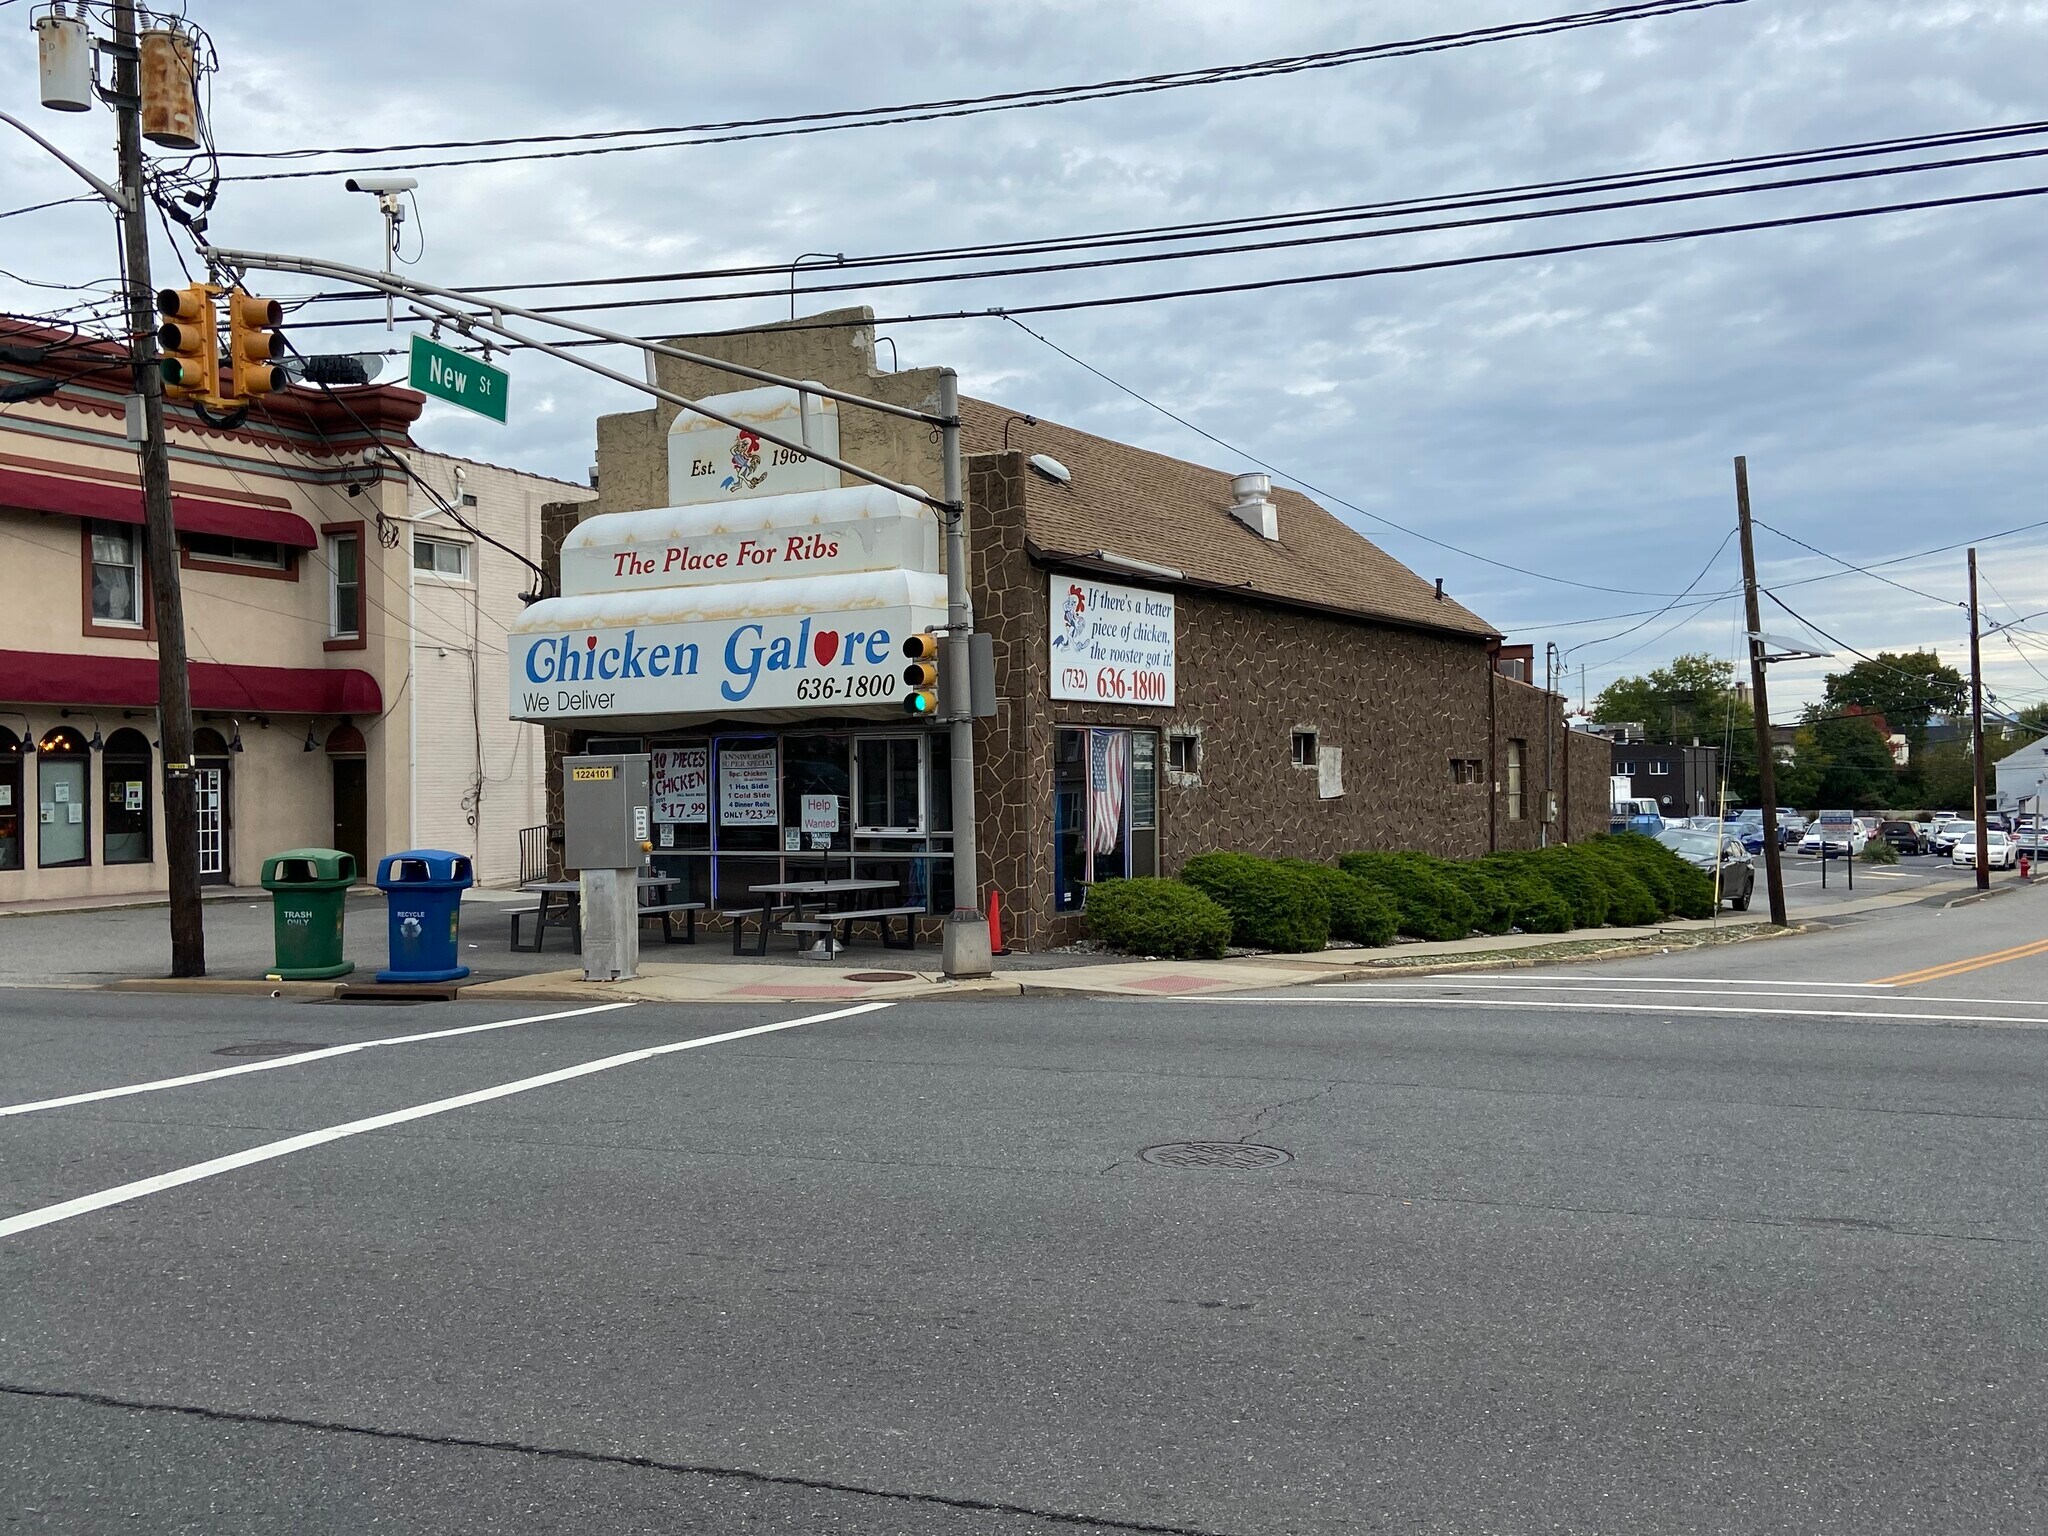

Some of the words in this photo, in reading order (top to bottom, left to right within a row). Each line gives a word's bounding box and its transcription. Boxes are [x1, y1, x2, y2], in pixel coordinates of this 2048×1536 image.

[430, 354, 467, 393] New
[480, 376, 491, 395] St
[691, 460, 715, 476] Est.
[614, 552, 655, 576] The
[663, 547, 728, 572] Place
[736, 540, 777, 566] For
[784, 534, 838, 562] Ribs
[1088, 588, 1099, 611] If
[1101, 591, 1132, 612] there's
[1136, 601, 1141, 613] a
[1145, 597, 1171, 617] better
[1091, 617, 1117, 639] piece
[1121, 621, 1132, 642] of
[1134, 623, 1170, 646] chicken,
[526, 630, 698, 683] Chicken
[1090, 642, 1106, 660] the
[1110, 648, 1143, 663] rooster
[1146, 652, 1160, 669] got
[1163, 649, 1173, 667] it!
[797, 674, 895, 700] 636-1800
[1062, 668, 1088, 692] (732)
[1097, 667, 1165, 701] 636-1800
[523, 692, 549, 712] We
[558, 690, 615, 711] Deliver
[654, 752, 667, 768] 10
[672, 751, 706, 768] PIECES
[576, 770, 610, 778] 1224101
[655, 769, 705, 796] CHICKEN
[661, 802, 706, 818] $17.99
[745, 809, 776, 819] $23.99
[808, 799, 831, 813] Help
[805, 819, 836, 828] Wanted
